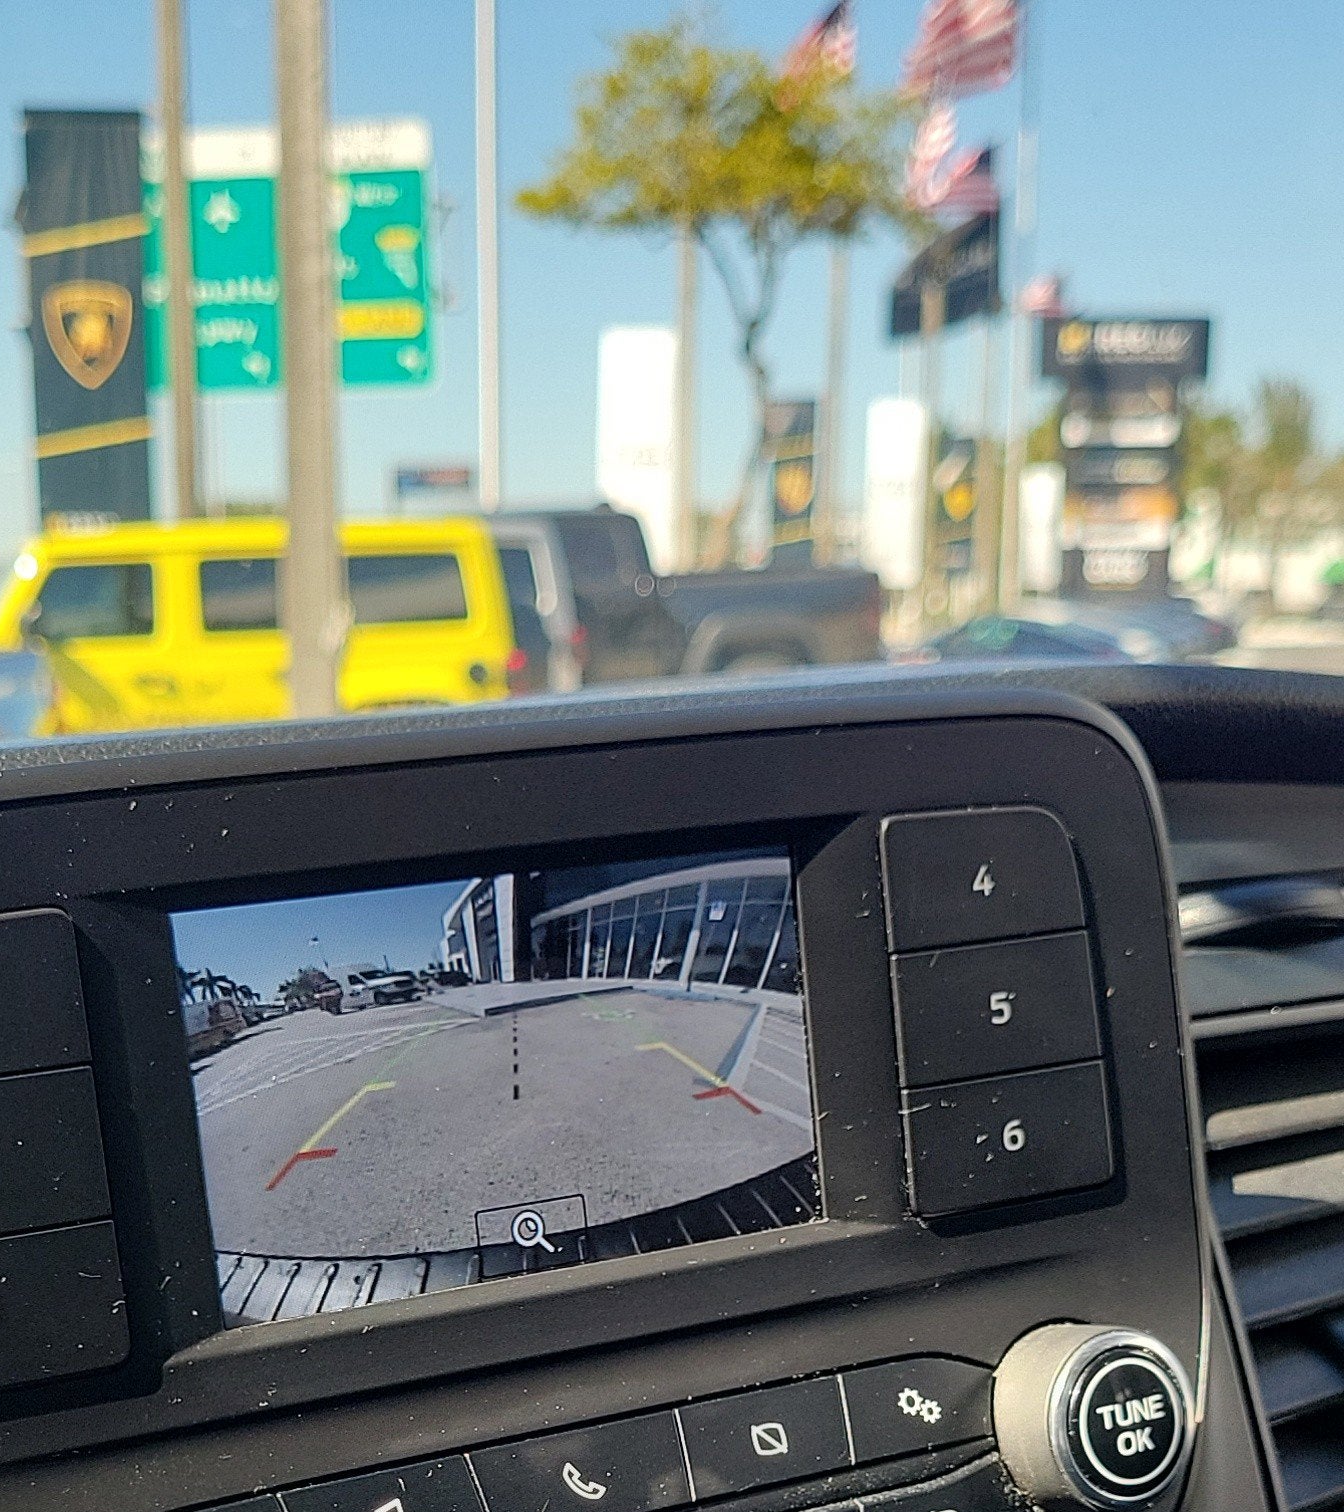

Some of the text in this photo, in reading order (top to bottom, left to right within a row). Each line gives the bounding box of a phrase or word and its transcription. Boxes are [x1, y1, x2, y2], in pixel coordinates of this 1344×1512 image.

[972, 864, 996, 897] 4
[989, 991, 1012, 1025] 5
[1002, 1119, 1026, 1152] 6
[1095, 1393, 1166, 1430] TUNE
[1116, 1426, 1156, 1457] OK
